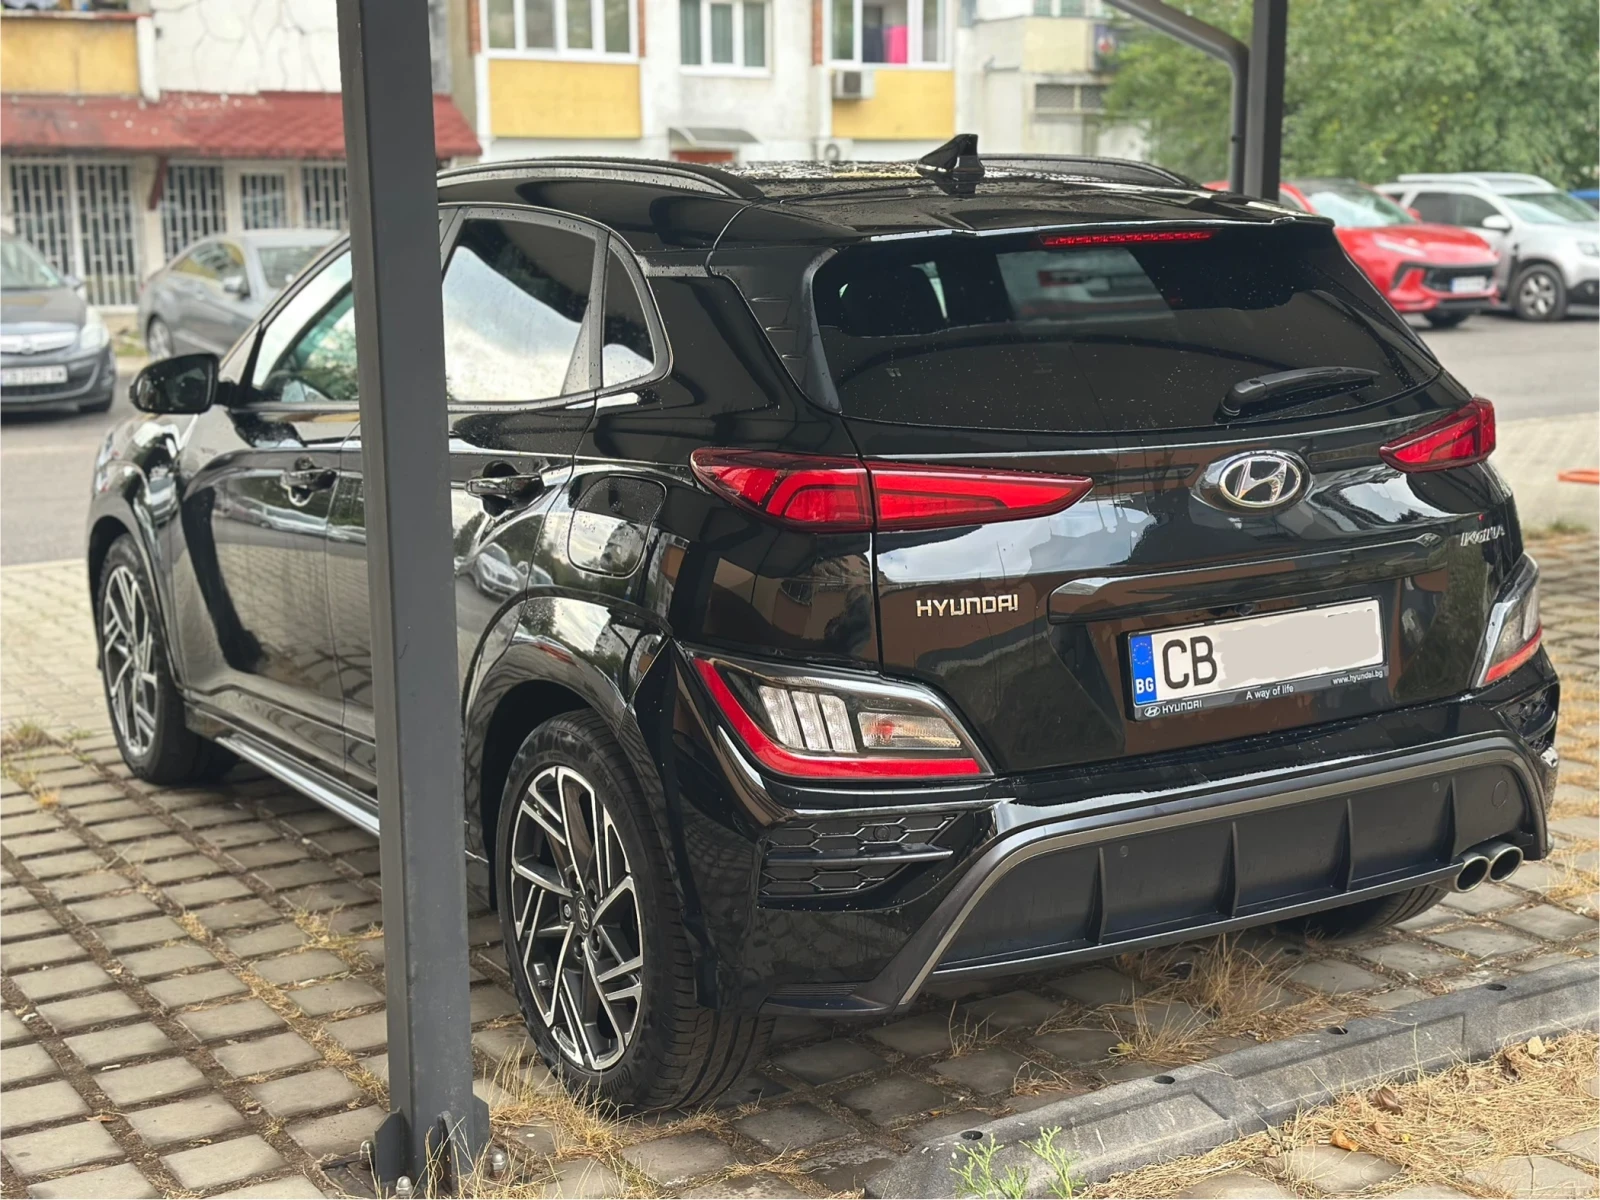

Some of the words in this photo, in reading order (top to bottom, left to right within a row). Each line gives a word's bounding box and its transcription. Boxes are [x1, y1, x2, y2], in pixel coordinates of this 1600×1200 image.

[916, 594, 1019, 617] HYUNDAI
[1135, 677, 1155, 695] BG
[1162, 635, 1218, 690] CB
[1332, 669, 1384, 685] www.hyundai.bg
[1245, 690, 1253, 700] A
[1254, 688, 1271, 699] way
[1272, 685, 1281, 696] of
[1282, 684, 1294, 694] life
[1162, 699, 1203, 714] HYUNDAI
